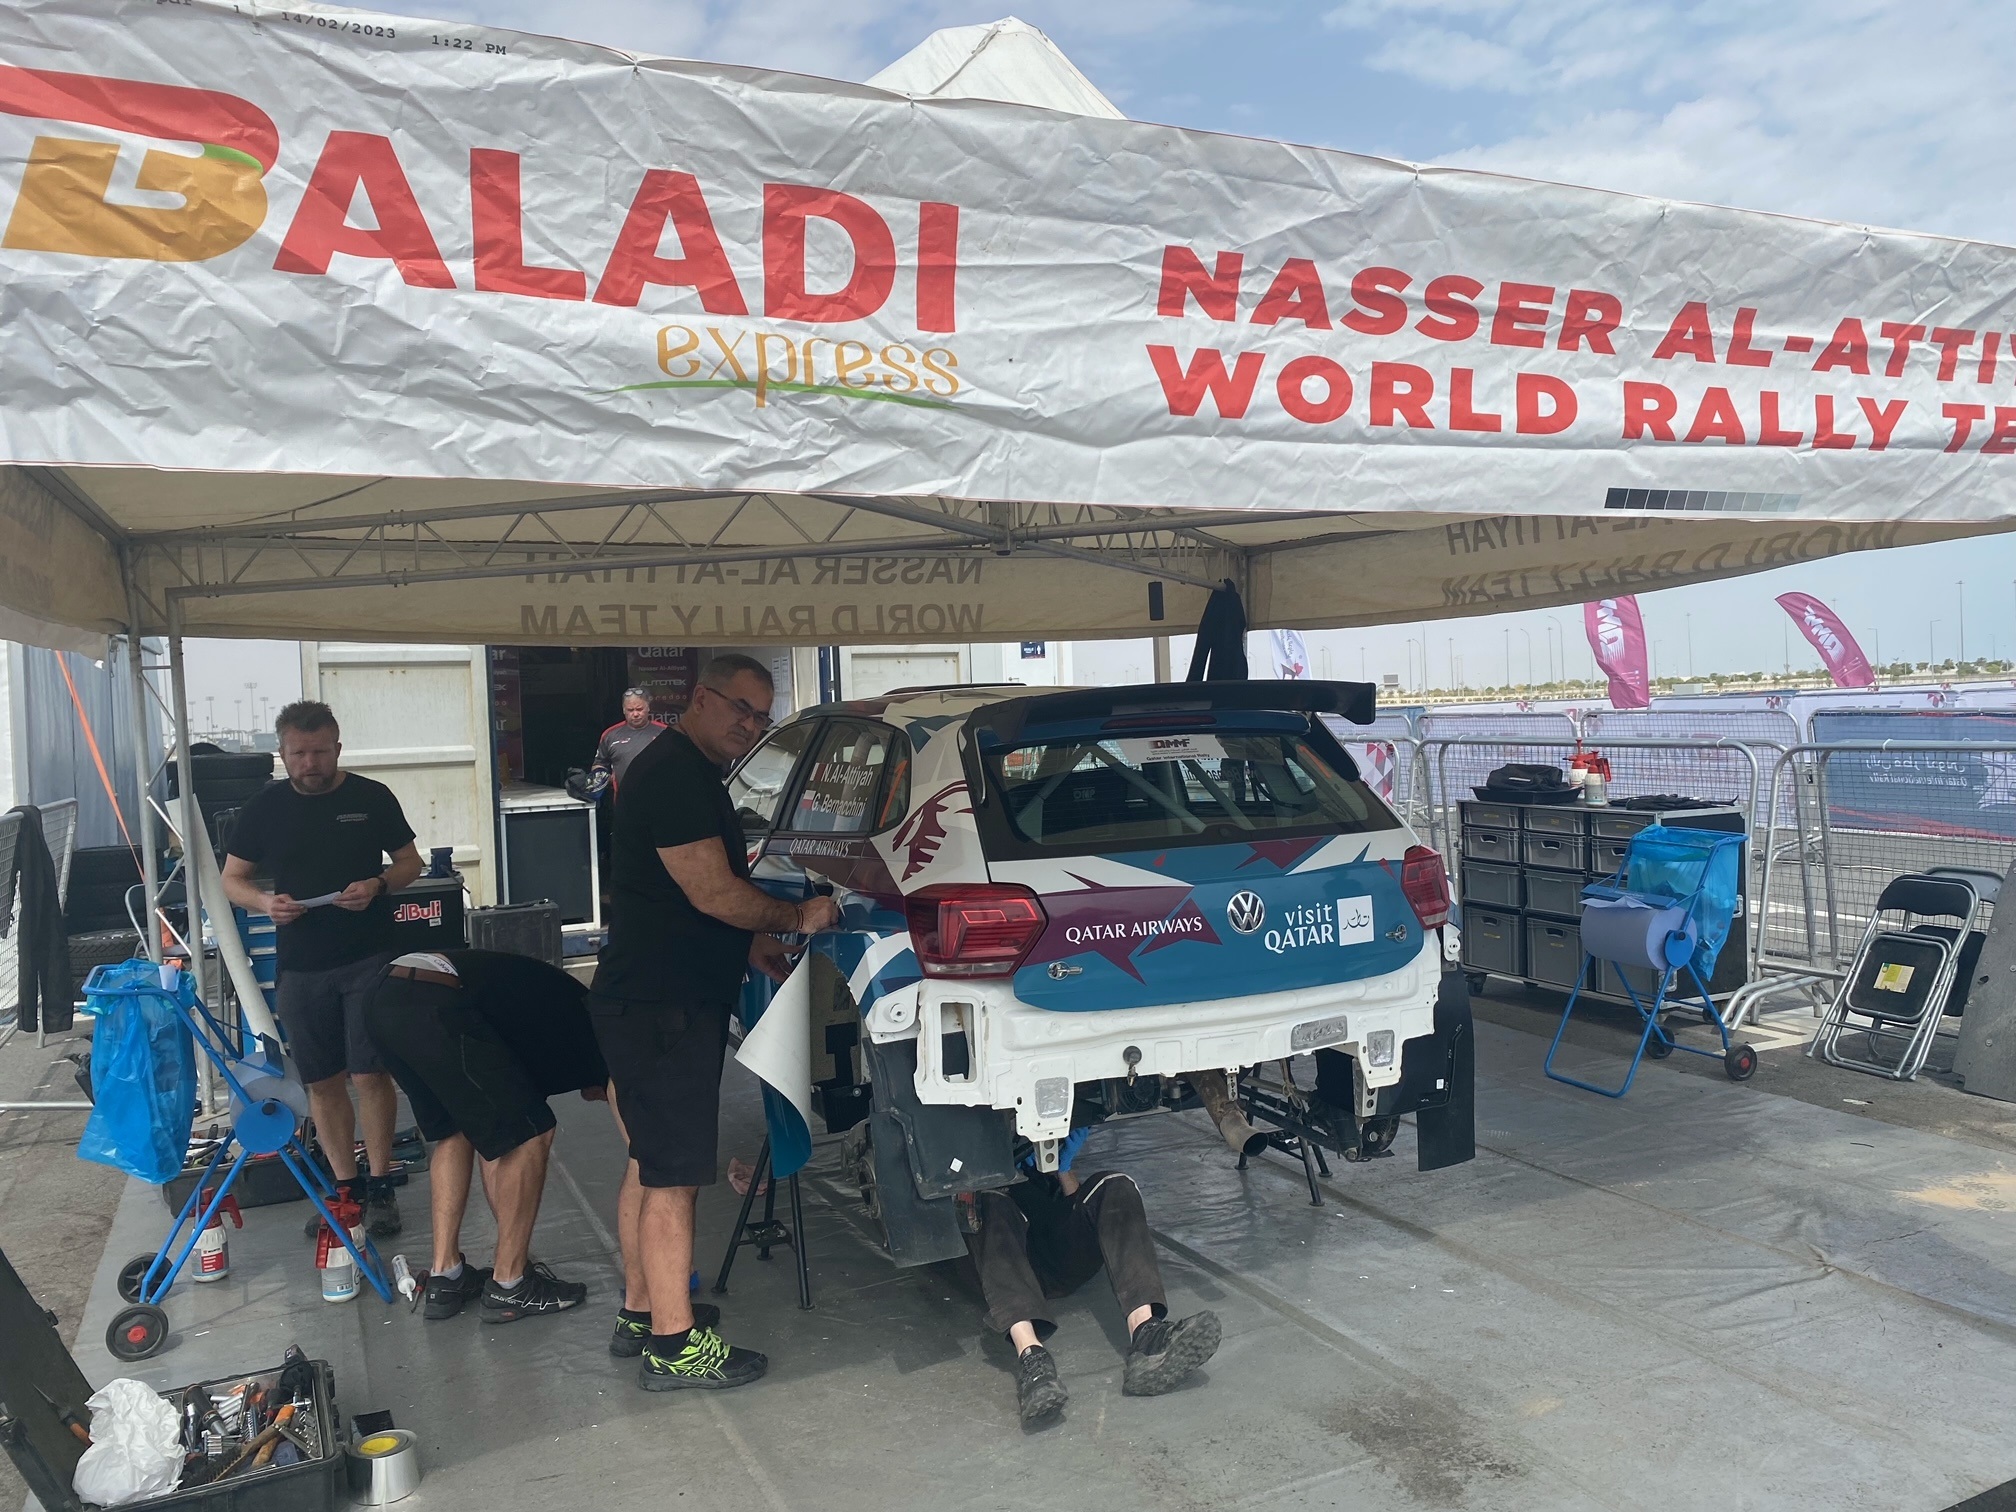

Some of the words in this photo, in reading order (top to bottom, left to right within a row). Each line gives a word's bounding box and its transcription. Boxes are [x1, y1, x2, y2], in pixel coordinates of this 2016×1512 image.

[281, 11, 396, 39] 14/02/2023
[431, 35, 474, 51] 1:22
[485, 43, 507, 56] PM
[1156, 245, 1622, 355] NASSER
[1652, 301, 2016, 384] AL-ATTI
[656, 324, 959, 407] express
[1145, 344, 1578, 436] WORLD
[1621, 380, 1909, 453] RALLY
[789, 838, 815, 856] QATAR
[813, 840, 851, 858] AIRWAYS
[1065, 924, 1126, 946] QATAR
[1131, 915, 1202, 938] AIRWAYS
[1284, 903, 1333, 926] visit
[1264, 925, 1335, 954] QATAR
